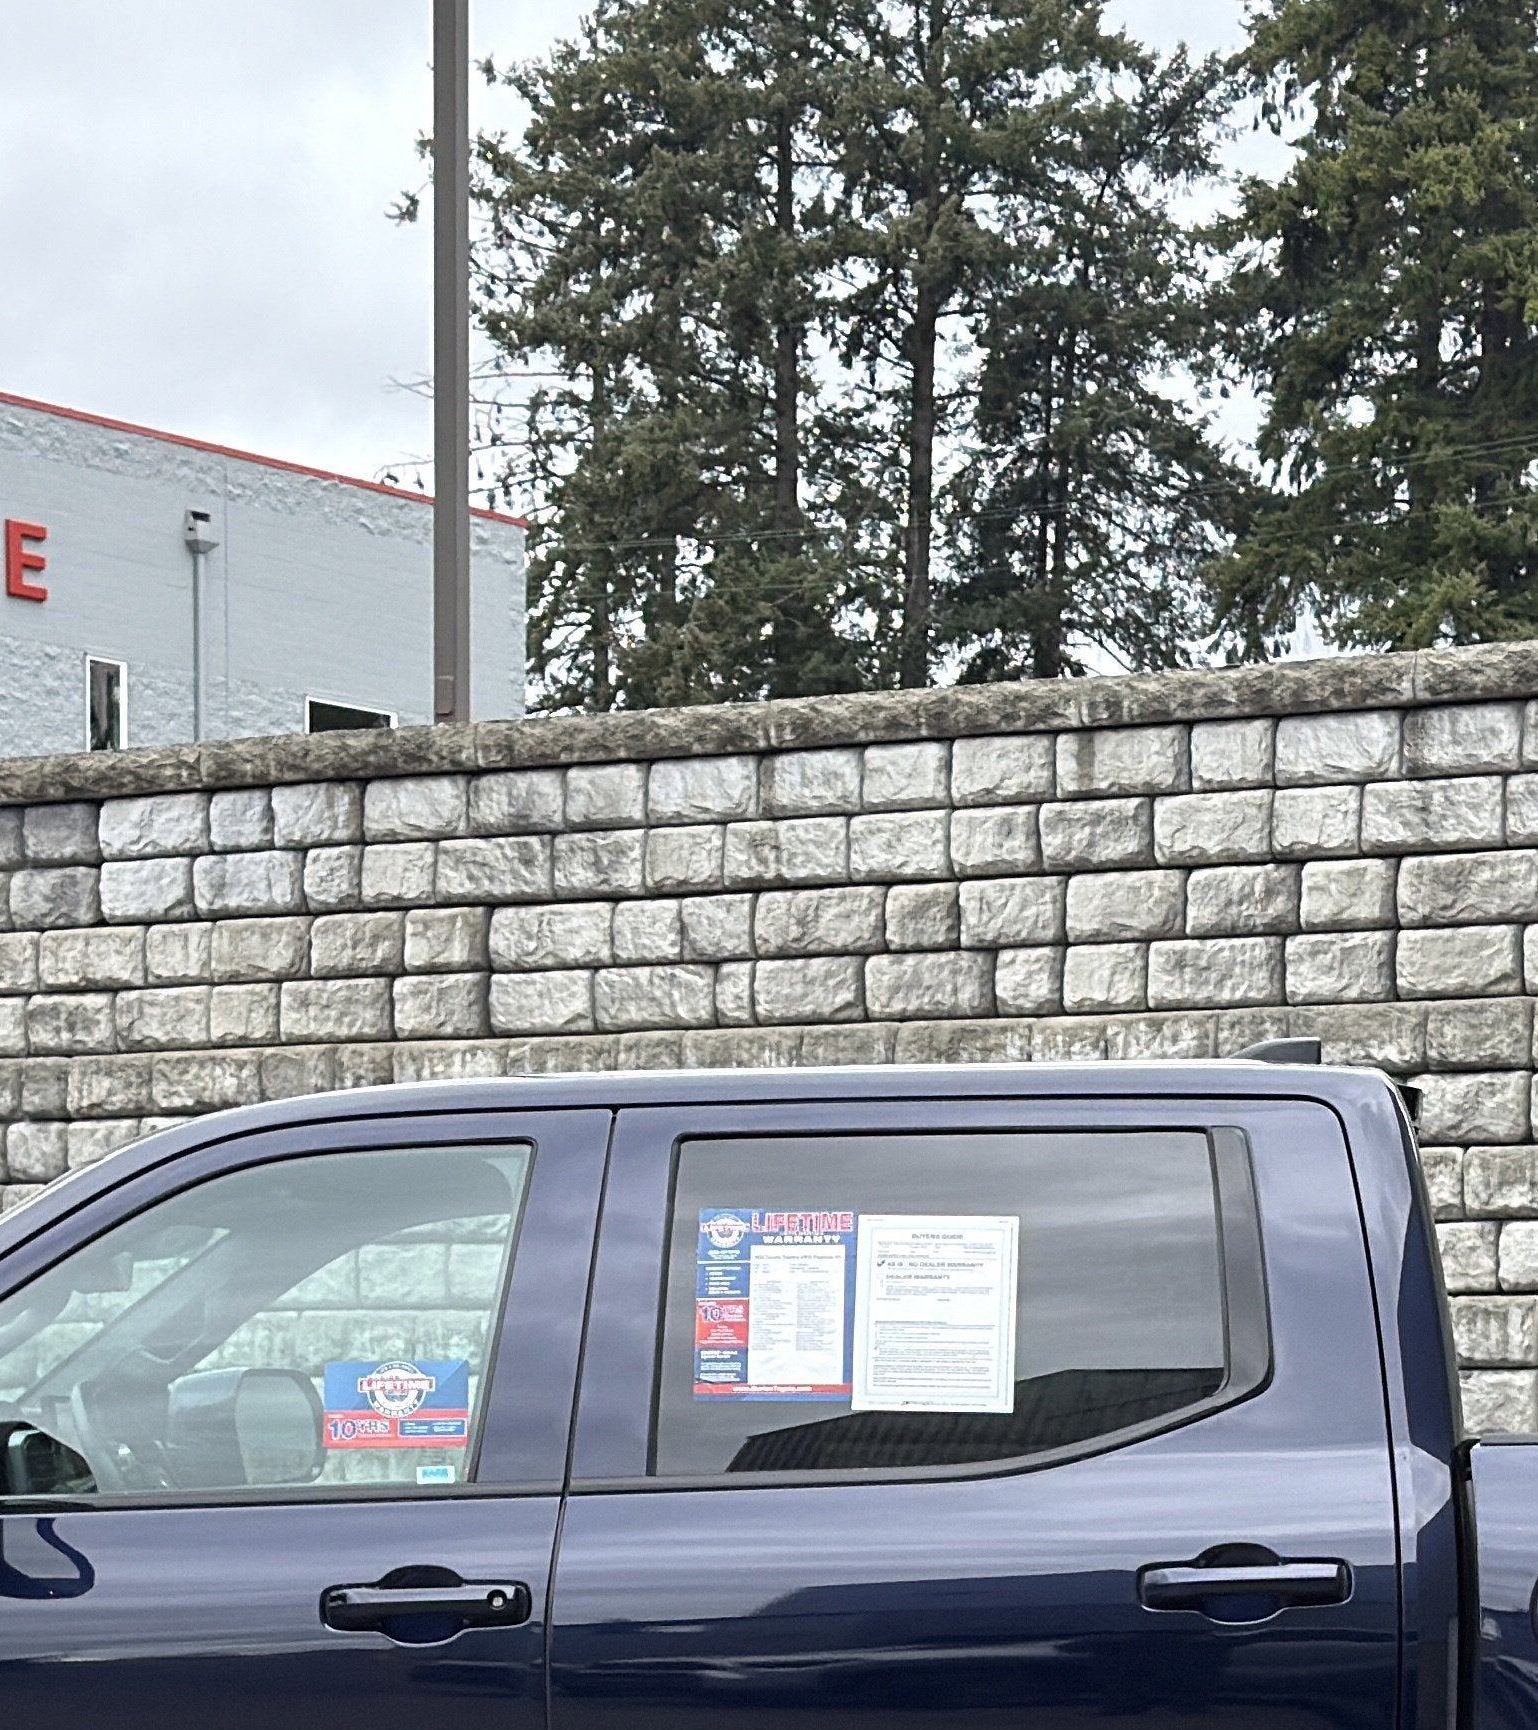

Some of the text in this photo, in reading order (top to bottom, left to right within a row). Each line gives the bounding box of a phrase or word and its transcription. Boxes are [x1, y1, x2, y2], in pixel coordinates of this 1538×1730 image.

[751, 1212, 854, 1233] LIFETIME
[762, 1235, 842, 1244] WARRANTY
[362, 1379, 430, 1391] LIFETIME
[327, 1419, 357, 1440] 10
